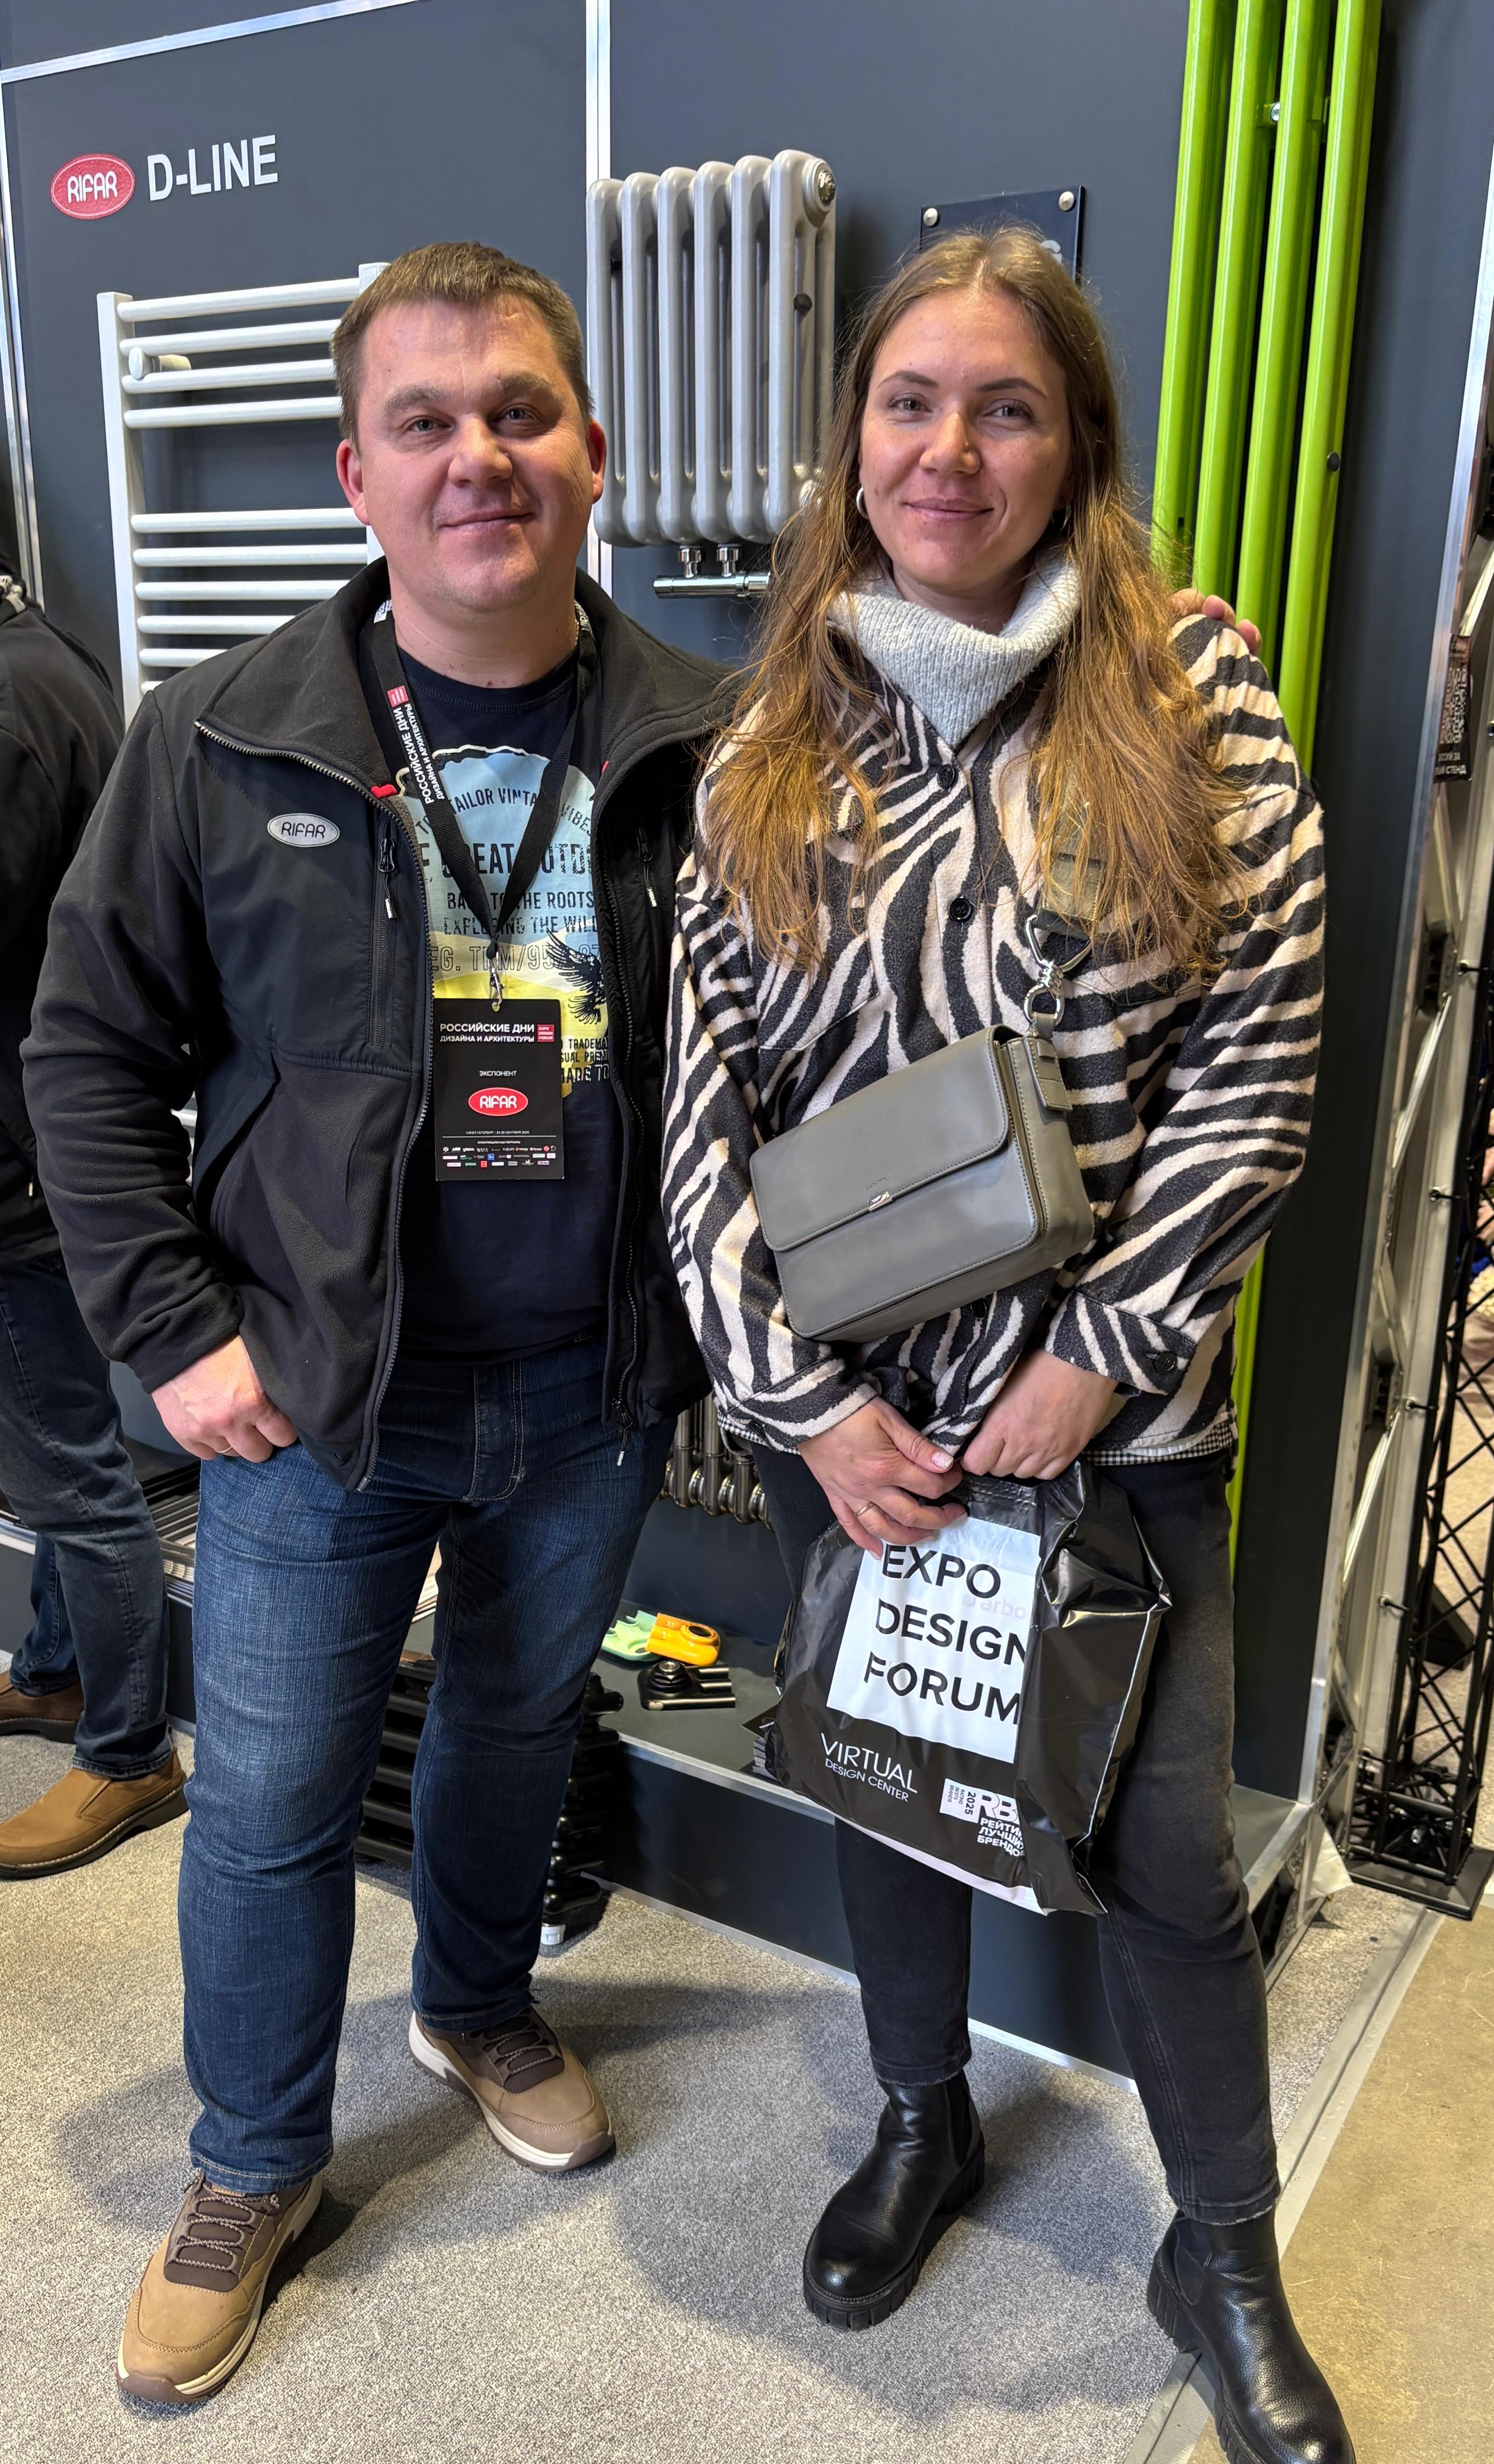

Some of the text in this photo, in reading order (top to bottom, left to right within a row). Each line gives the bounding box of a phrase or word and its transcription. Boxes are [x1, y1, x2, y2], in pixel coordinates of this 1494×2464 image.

[147, 134, 278, 201] D-LINE
[67, 170, 118, 204] RIFAR
[393, 707, 410, 732] ДНИ
[405, 703, 428, 756] АРХИТЕКТУРЫ
[402, 732, 435, 804] РОССИЙСКИЕ
[425, 764, 445, 800] ДИЗАЙНА
[498, 787, 537, 806] VINTA
[281, 822, 326, 839] RIFAR
[447, 892, 466, 910] BA
[517, 891, 541, 909] HE
[547, 891, 595, 909] ROOTS
[531, 916, 559, 934] THE
[440, 1022, 534, 1034] РОССИЙСКИЕ ДНИ
[440, 1034, 475, 1042] ДИЗАЙНА
[568, 1037, 608, 1050] TRADEMA
[560, 1051, 581, 1063] SUAL
[479, 1095, 517, 1109] RIFAR
[881, 1544, 1001, 1599] EXPO
[875, 1597, 1027, 1666] DESIGN
[863, 1651, 1022, 1725] FORUM
[820, 1732, 918, 1794] VIRTUAL
[825, 1758, 909, 1802] DESIGN CENTER
[964, 1791, 976, 1815] 2025
